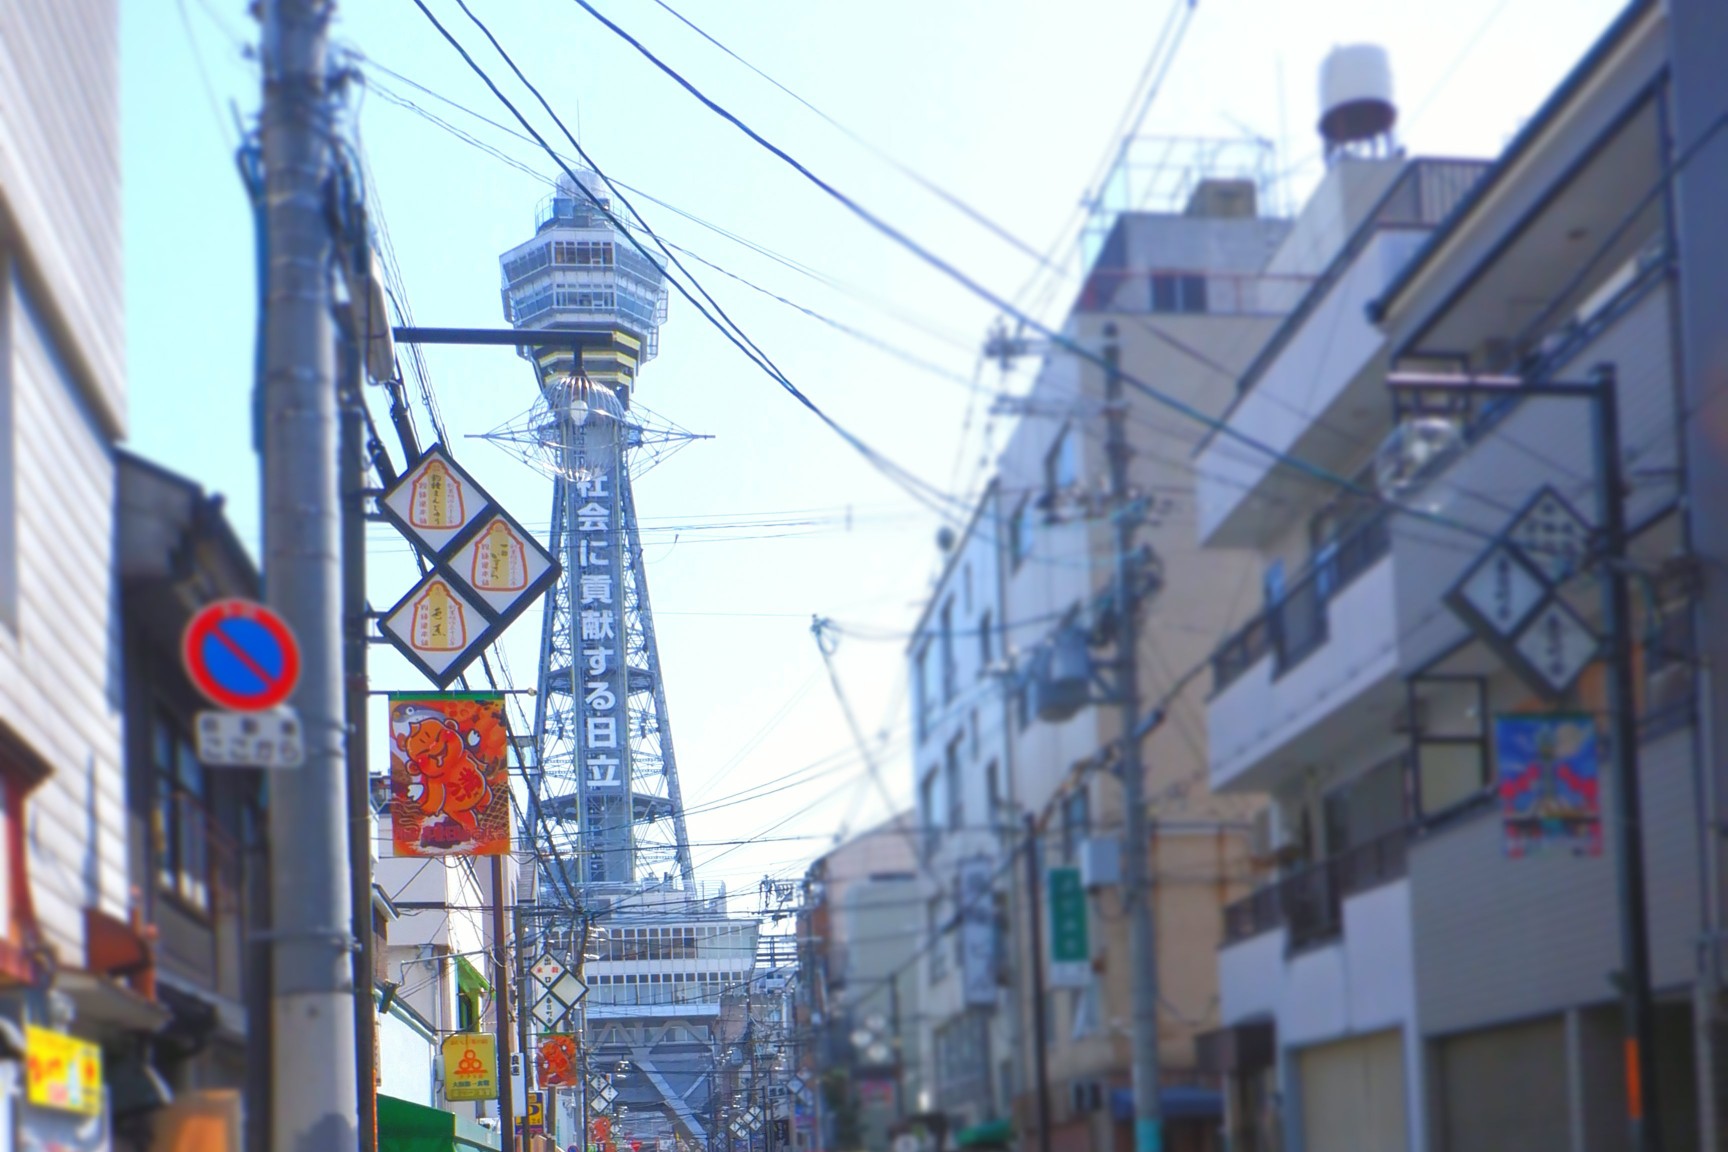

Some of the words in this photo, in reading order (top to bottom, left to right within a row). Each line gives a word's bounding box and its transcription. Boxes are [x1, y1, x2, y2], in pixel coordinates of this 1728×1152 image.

[576, 474, 621, 787] 社会に貢献する日立
[204, 737, 300, 763] ここから
